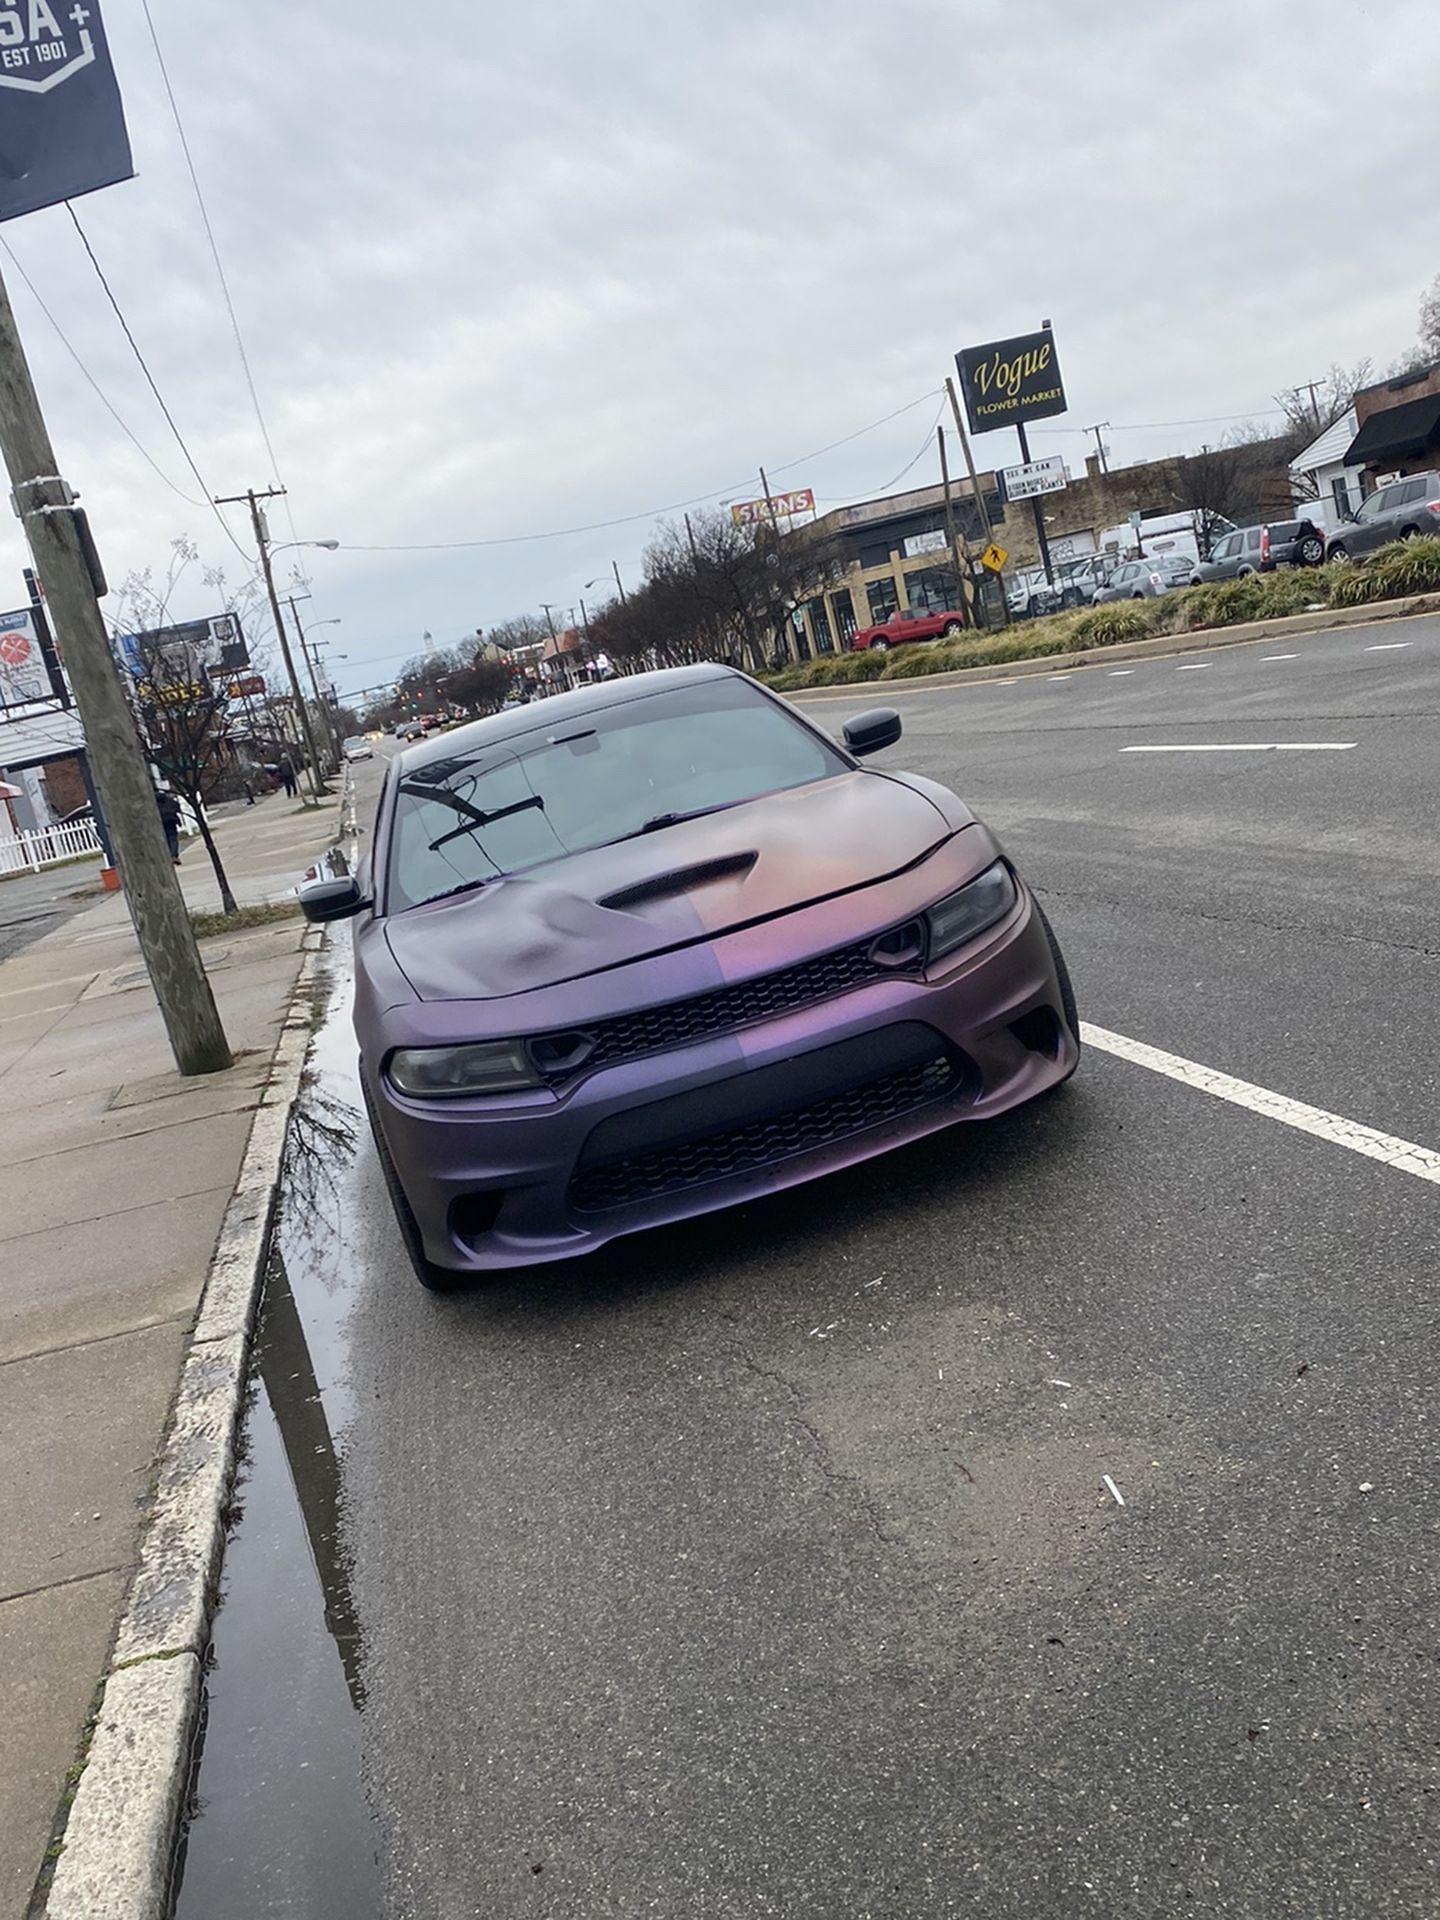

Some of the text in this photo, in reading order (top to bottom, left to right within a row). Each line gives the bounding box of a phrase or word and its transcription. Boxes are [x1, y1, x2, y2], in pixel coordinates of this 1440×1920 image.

[2, 40, 68, 68] EST 1901
[974, 343, 1051, 396] Vogue
[976, 387, 1062, 416] FLOWER MARKET
[1036, 462, 1051, 471] CAN
[740, 493, 809, 522] SIGNS
